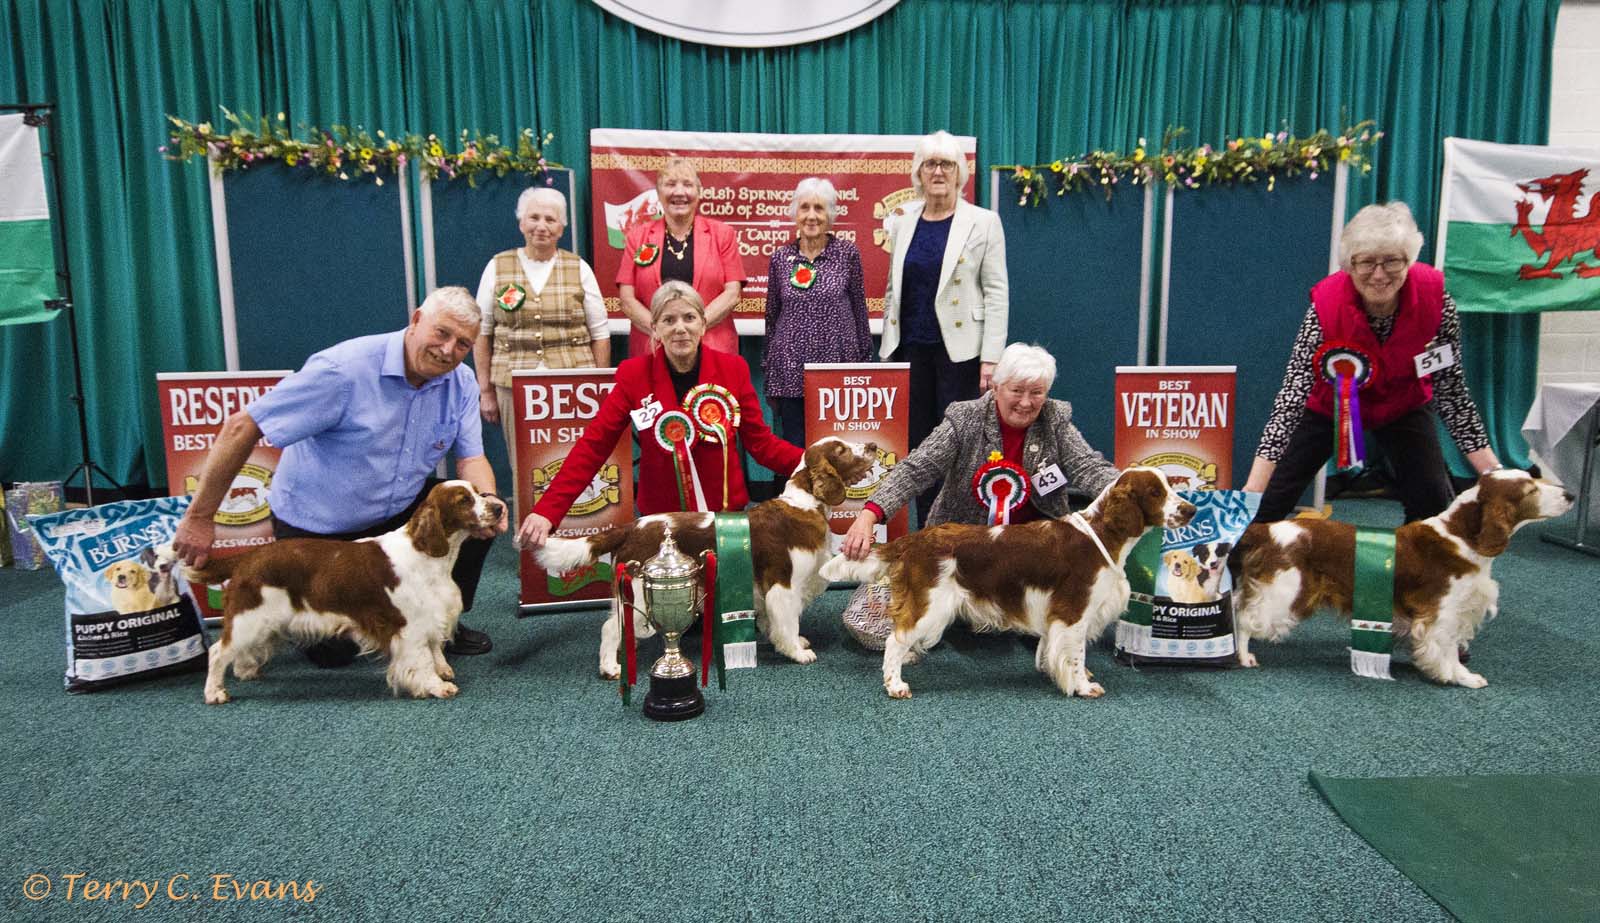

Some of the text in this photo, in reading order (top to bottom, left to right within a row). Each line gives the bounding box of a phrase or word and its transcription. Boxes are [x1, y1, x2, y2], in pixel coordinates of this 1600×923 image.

[738, 187, 794, 203] Springe
[755, 203, 792, 216] Sout
[1421, 354, 1443, 370] 51
[843, 376, 872, 386] BEST
[1158, 380, 1191, 390] BEST
[818, 386, 898, 421] PUPPY
[1121, 392, 1229, 428] VETERAN
[833, 421, 881, 431] IN SHOW
[1145, 429, 1200, 439] IN SHOW
[173, 433, 215, 452] BEST
[529, 426, 584, 444] IN SH
[1038, 471, 1058, 488] 43
[88, 521, 161, 564] BURNS
[1168, 604, 1222, 617] ORIGINAL
[75, 608, 182, 635] PUPPY ORIGINAL
